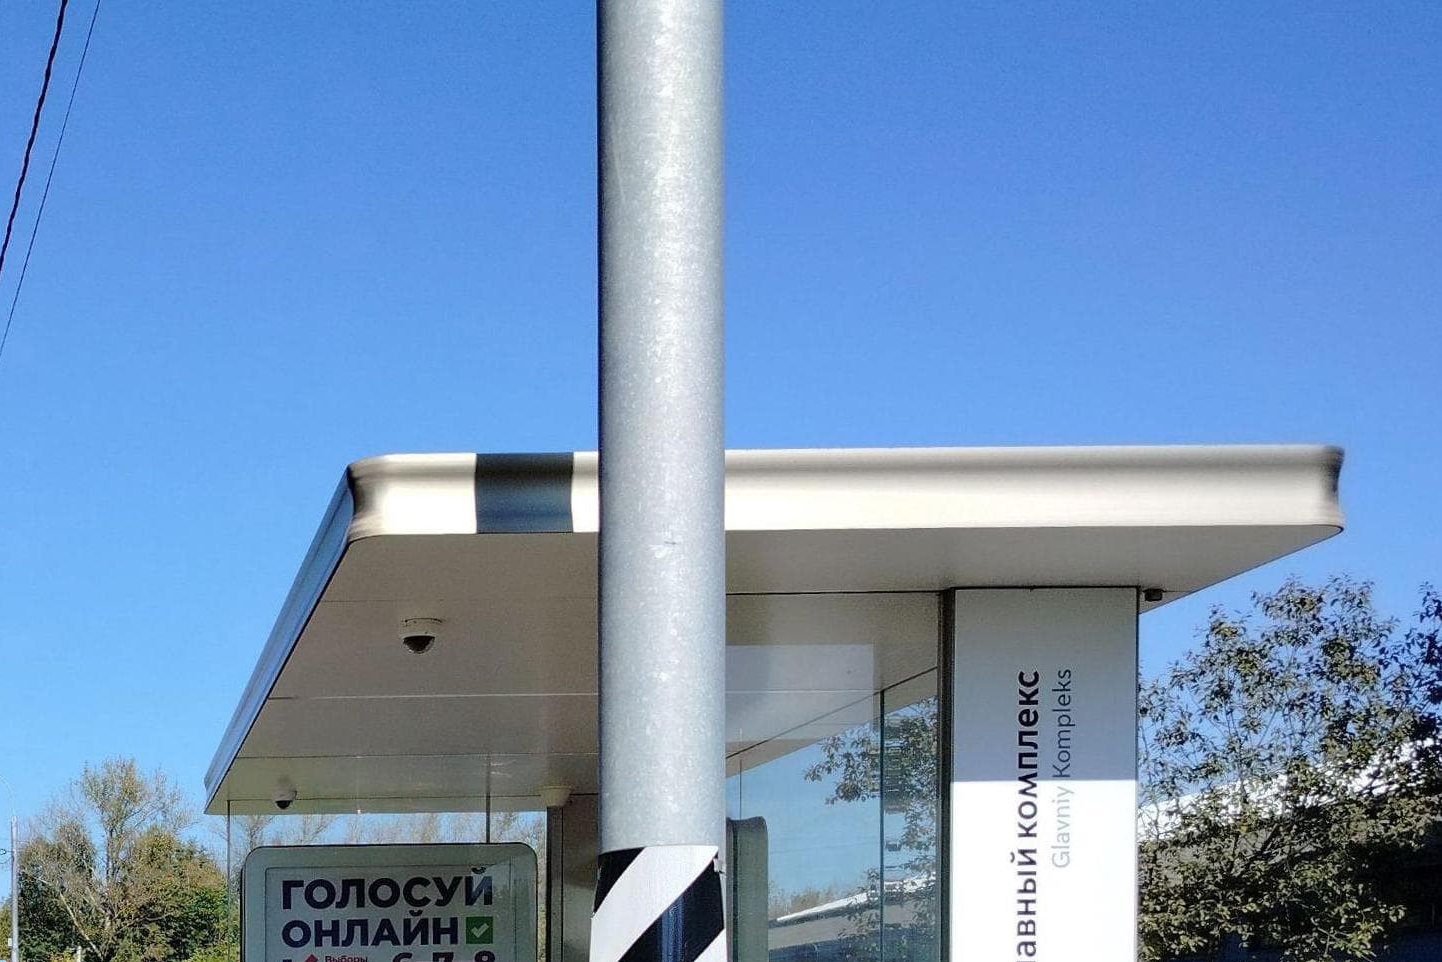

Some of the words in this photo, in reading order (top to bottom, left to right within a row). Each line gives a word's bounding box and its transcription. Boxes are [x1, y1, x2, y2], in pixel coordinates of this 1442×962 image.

[1017, 670, 1040, 838] комплекс
[1051, 668, 1076, 778] Kompleks
[1051, 785, 1075, 869] Glavniy
[281, 910, 459, 948] ОНЛАЙН
[282, 867, 493, 909] ГОЛОСУЙ
